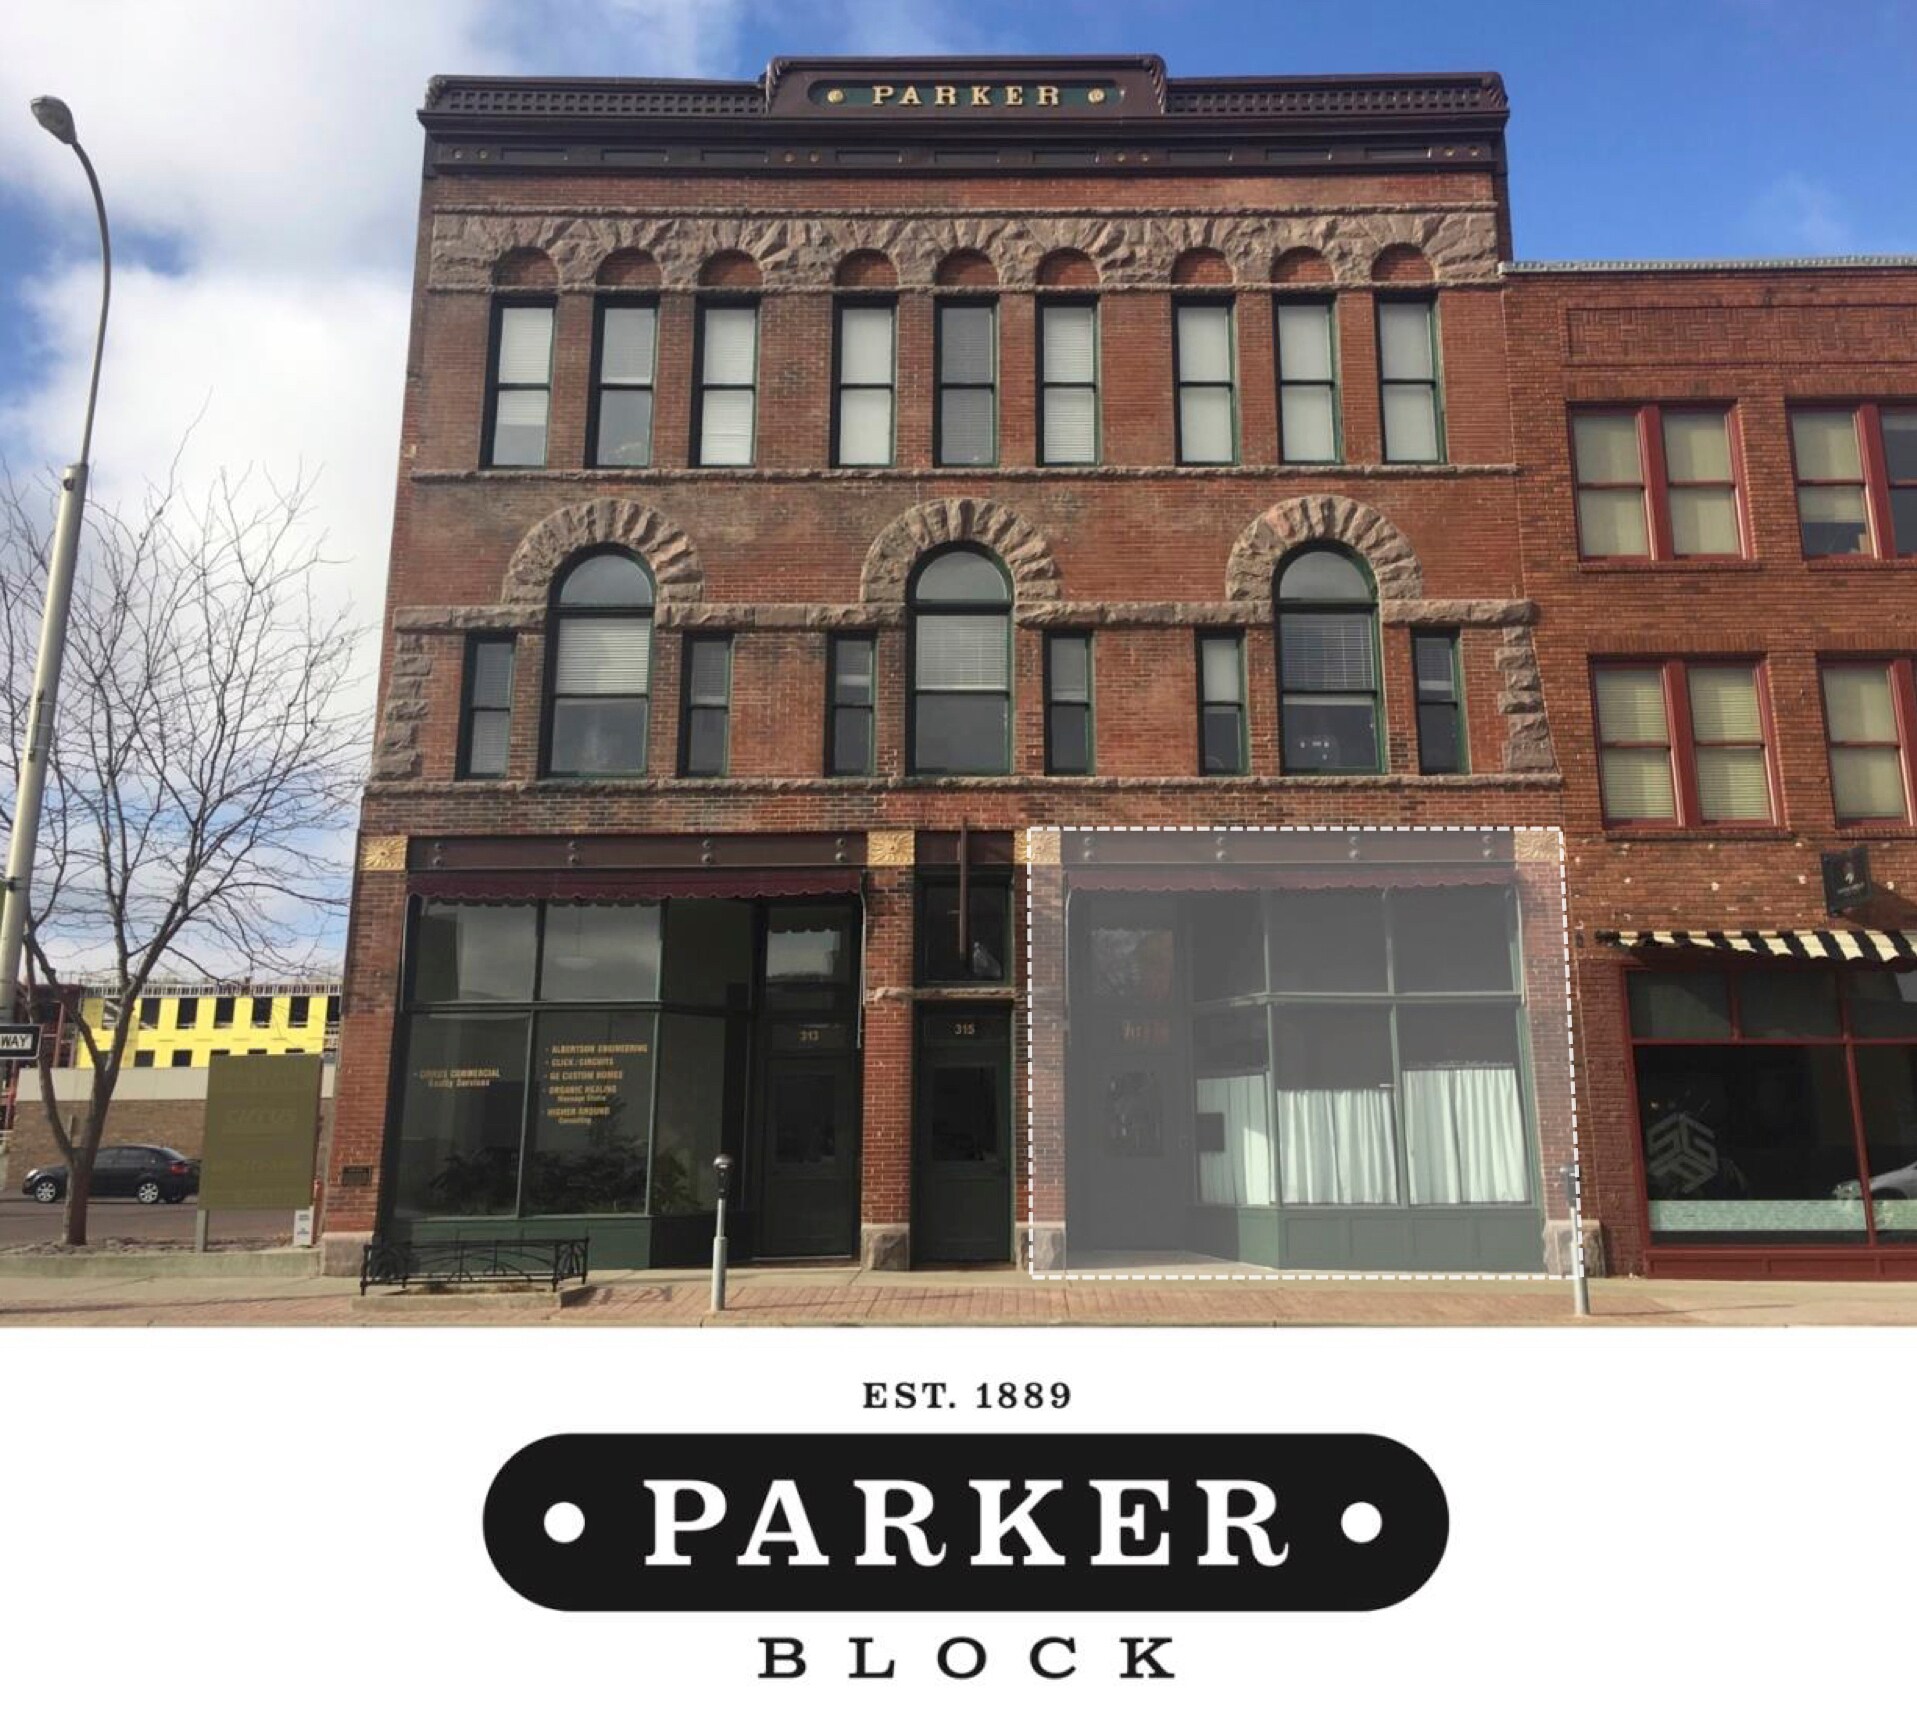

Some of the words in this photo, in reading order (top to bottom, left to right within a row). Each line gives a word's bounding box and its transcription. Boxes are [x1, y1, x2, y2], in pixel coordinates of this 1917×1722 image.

[872, 86, 1060, 106] PARKER
[954, 1023, 976, 1036] 315
[1, 1034, 29, 1049] WAY
